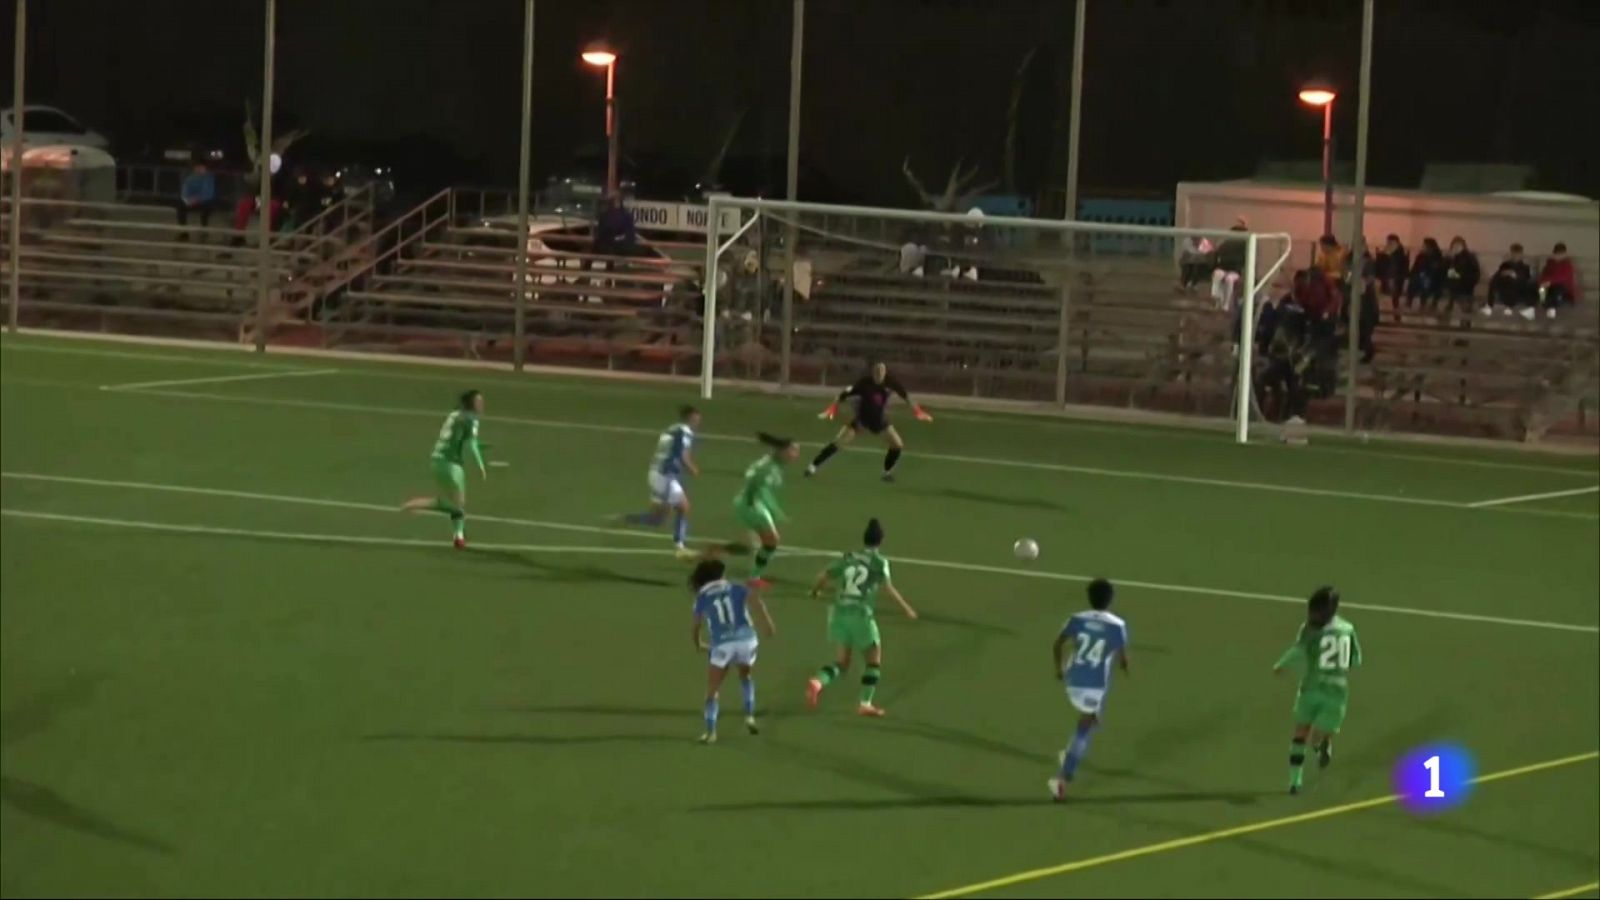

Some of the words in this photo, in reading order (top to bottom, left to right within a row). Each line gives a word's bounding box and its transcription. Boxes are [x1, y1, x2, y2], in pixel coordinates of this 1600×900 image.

[844, 564, 869, 596] 12
[713, 596, 735, 624] 11
[1075, 632, 1106, 668] 24
[1319, 634, 1351, 669] 20
